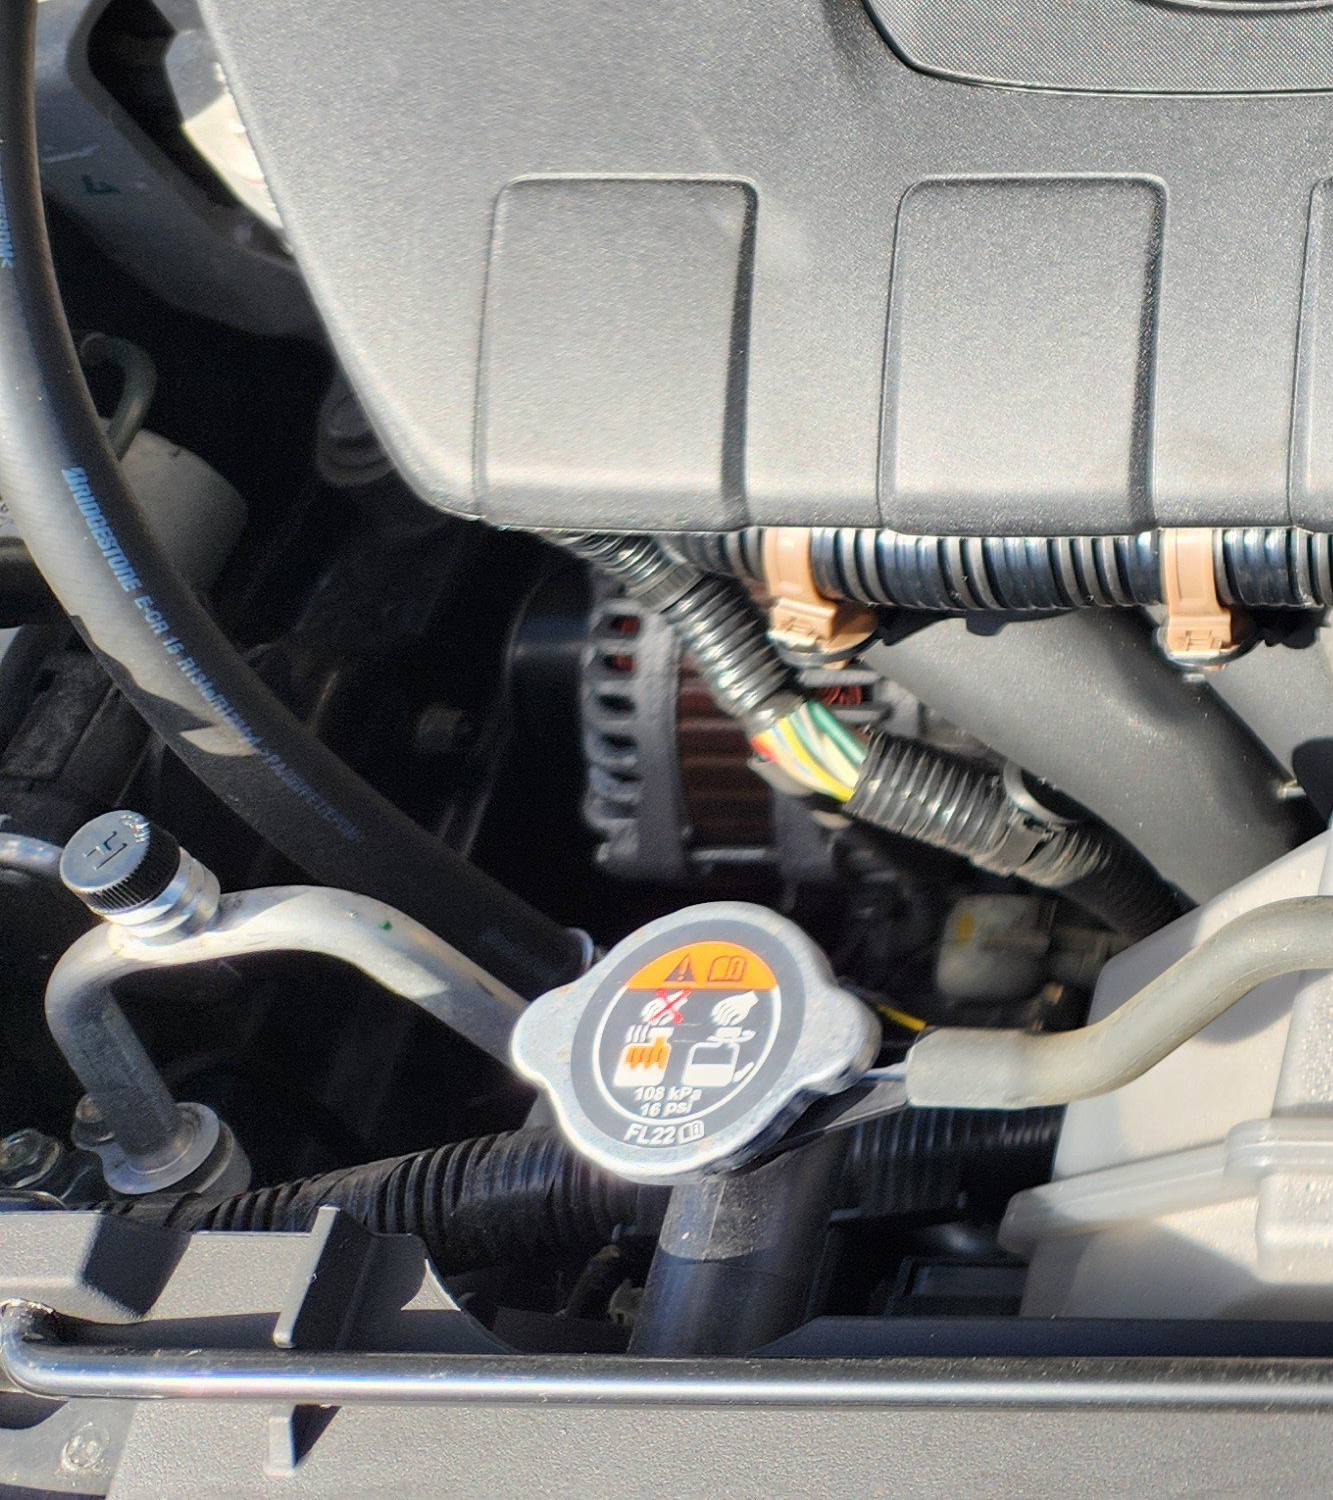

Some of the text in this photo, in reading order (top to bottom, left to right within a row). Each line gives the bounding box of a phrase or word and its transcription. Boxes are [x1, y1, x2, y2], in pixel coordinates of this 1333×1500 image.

[61, 466, 144, 593] BRIDGESTONE
[633, 1086, 703, 1102] 108 kPa
[639, 1099, 694, 1119] 16 psi
[623, 1123, 677, 1146] FL22
